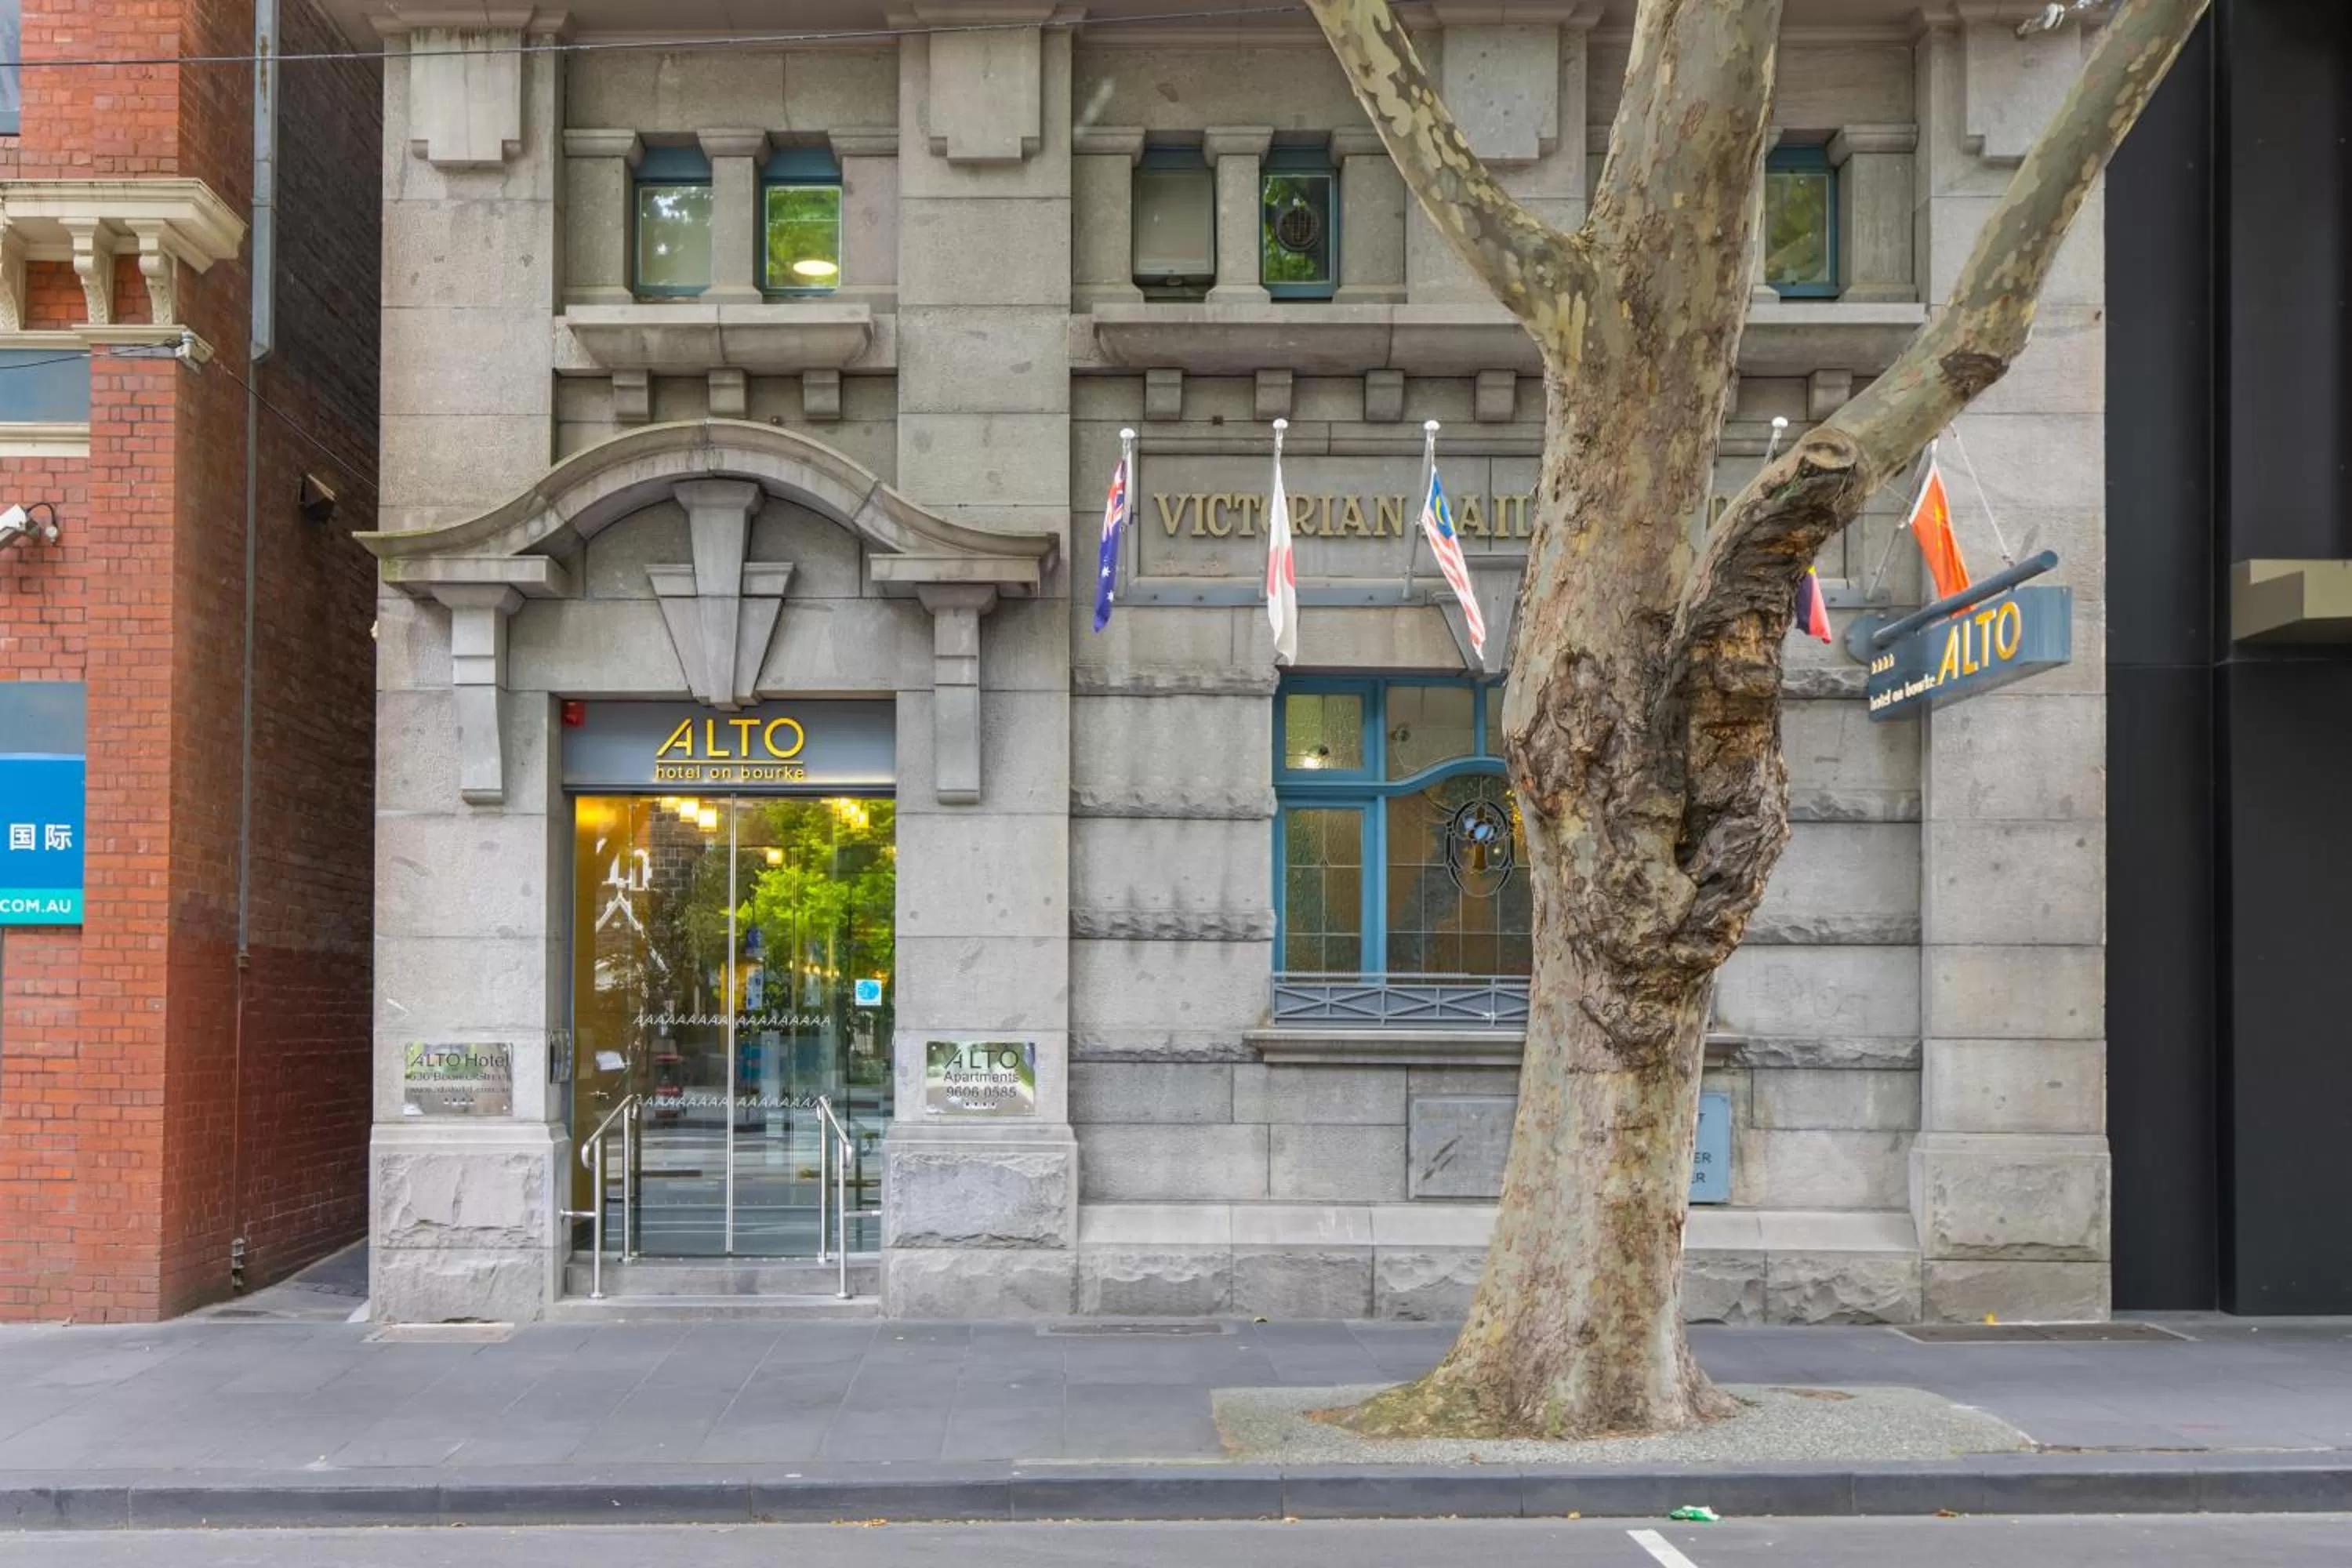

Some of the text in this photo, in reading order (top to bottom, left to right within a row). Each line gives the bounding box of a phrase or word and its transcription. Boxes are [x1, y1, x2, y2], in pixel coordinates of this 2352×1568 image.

[1422, 493, 1534, 537] AIL
[1936, 601, 2023, 686] ALTO
[657, 717, 805, 758] ALTO
[655, 764, 804, 780] hotel on bourke
[9, 823, 73, 851] 国际
[0, 898, 72, 913] COM.AU
[410, 1053, 509, 1067] ALTO Hotel
[944, 1049, 1019, 1069] ALTO
[943, 1071, 1019, 1084] Apartments
[1693, 1152, 1713, 1164] ER
